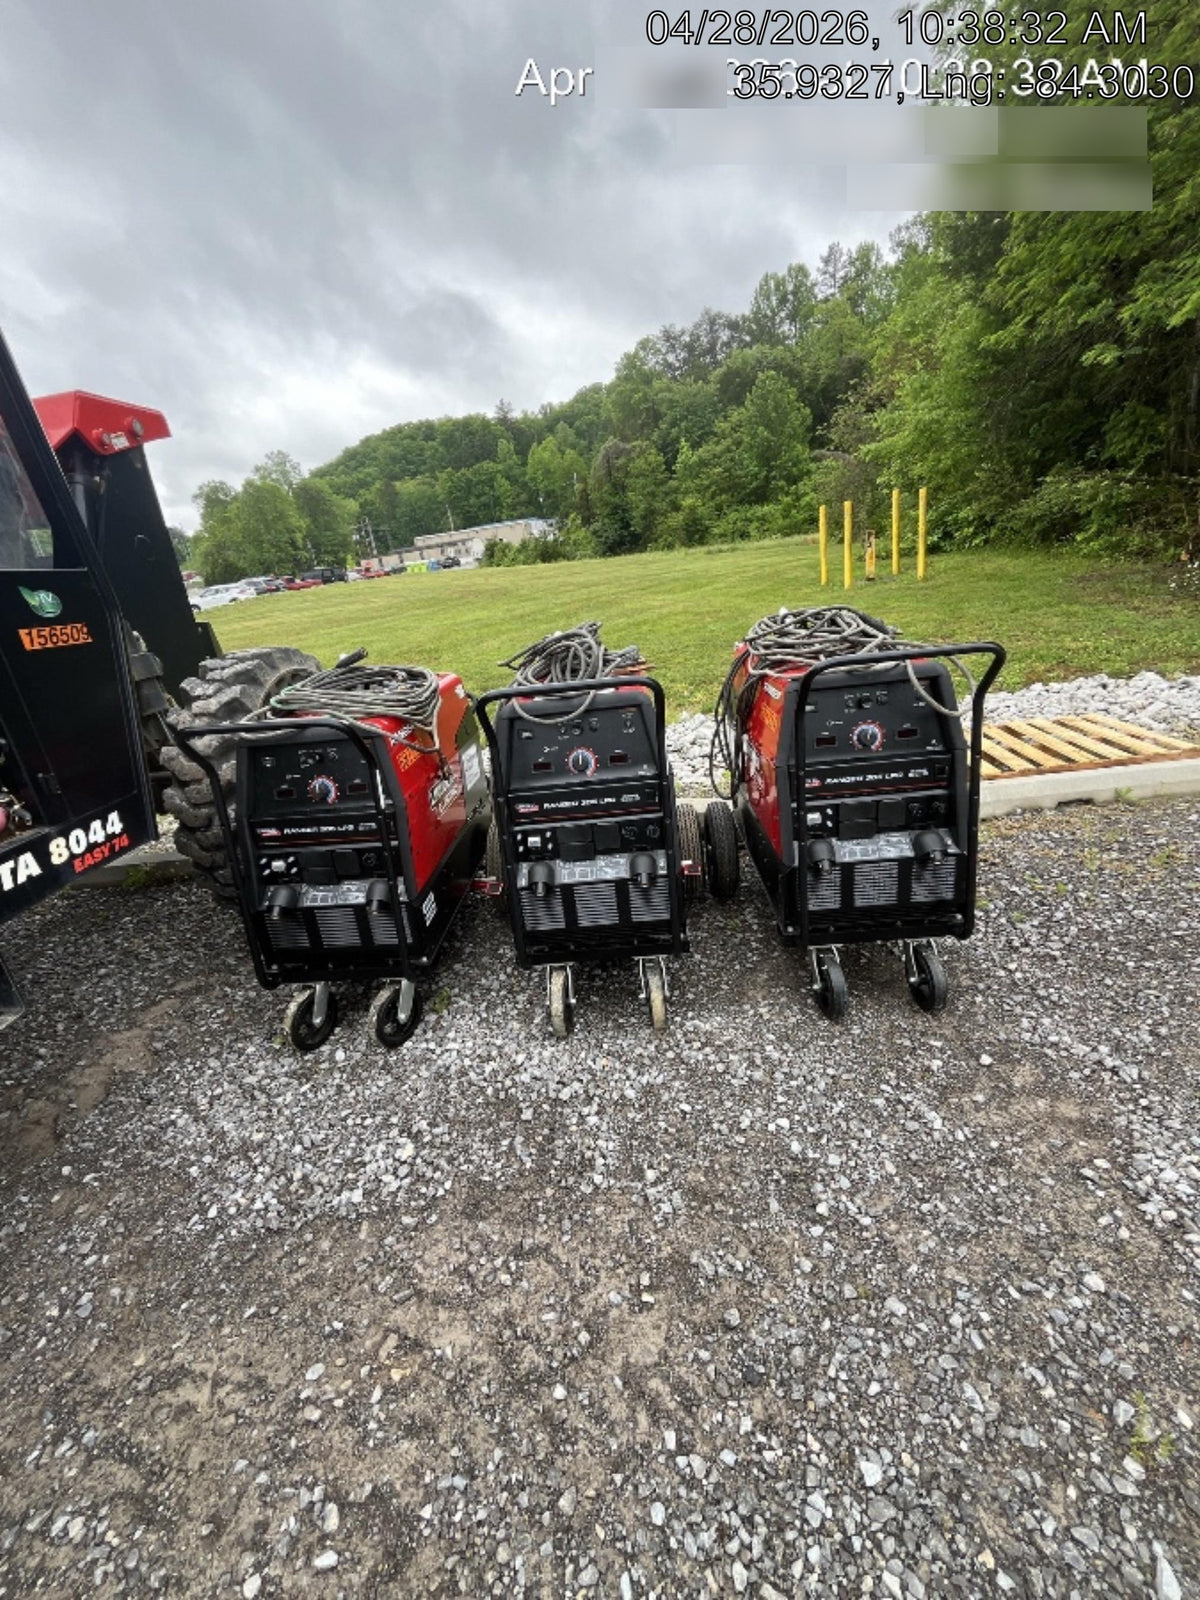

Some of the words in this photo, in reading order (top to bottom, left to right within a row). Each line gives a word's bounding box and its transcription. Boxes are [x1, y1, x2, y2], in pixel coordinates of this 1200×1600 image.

[25, 624, 89, 647] 156509
[48, 810, 123, 865] 8044
[73, 842, 111, 874] EASY
